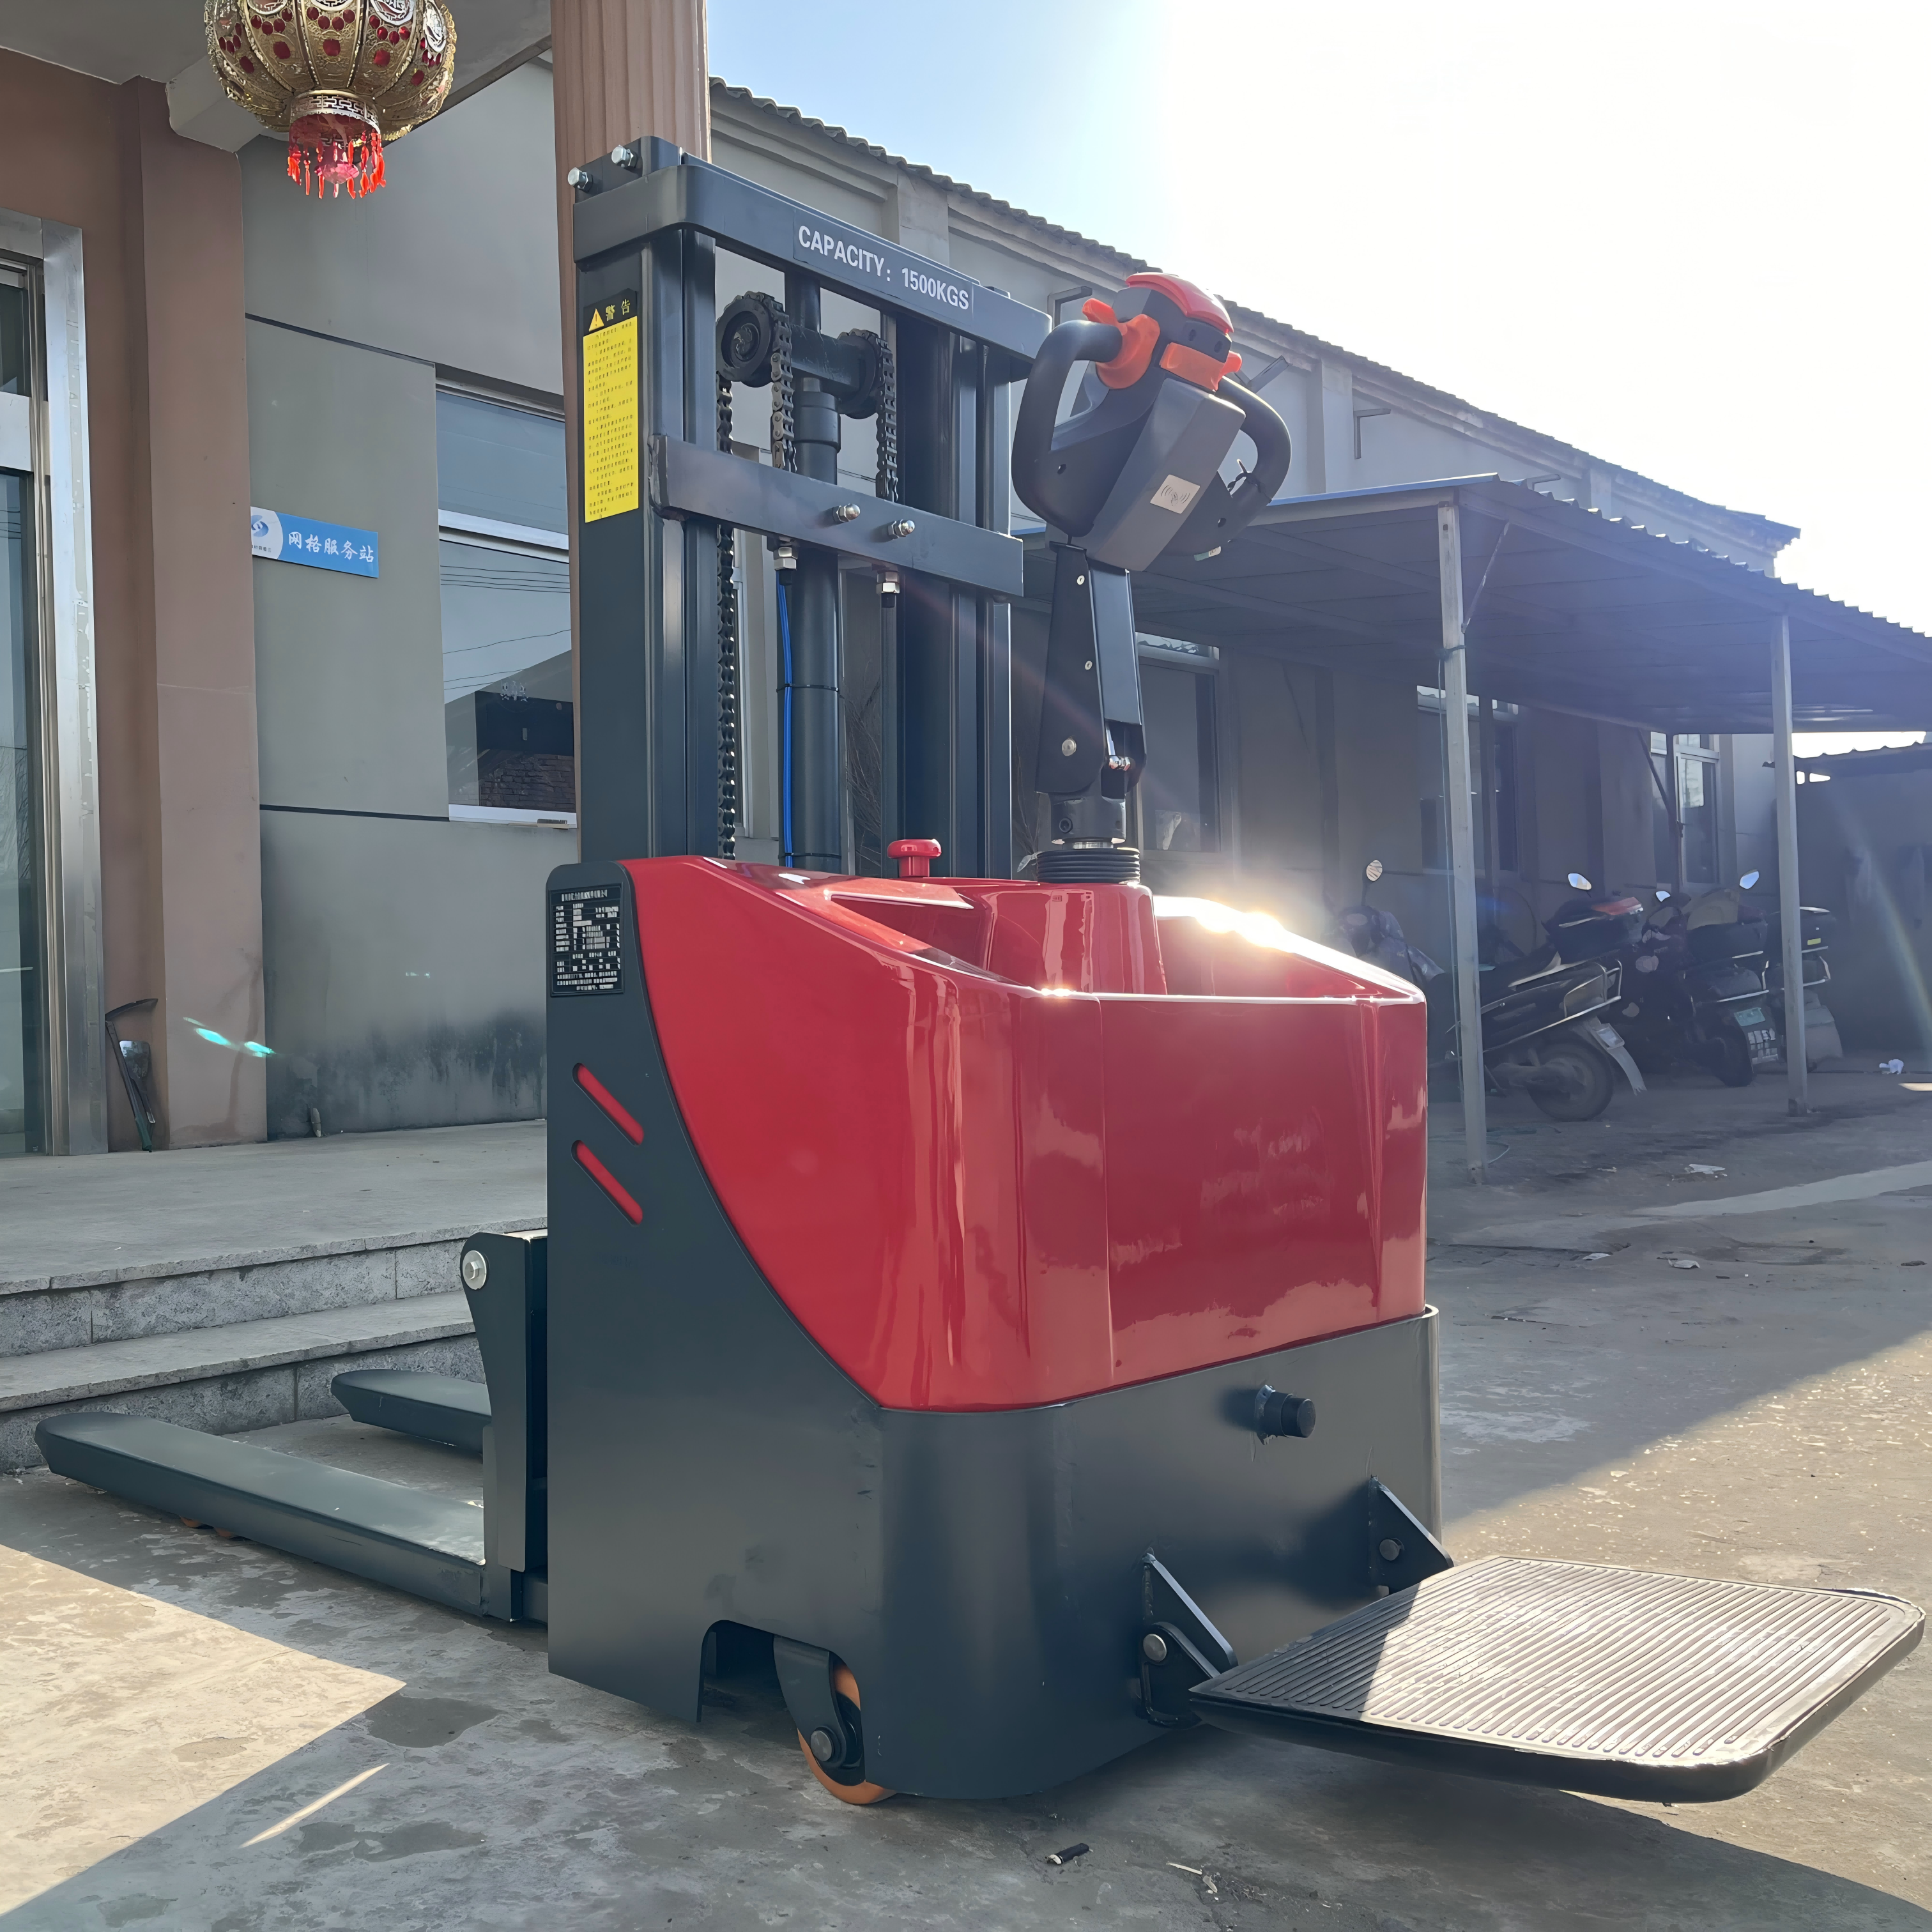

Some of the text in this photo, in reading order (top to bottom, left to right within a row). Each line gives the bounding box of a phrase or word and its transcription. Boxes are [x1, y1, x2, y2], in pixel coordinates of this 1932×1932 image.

[799, 226, 969, 310] CAPACITY: 1500KGS
[288, 532, 374, 562] 网格服务站
